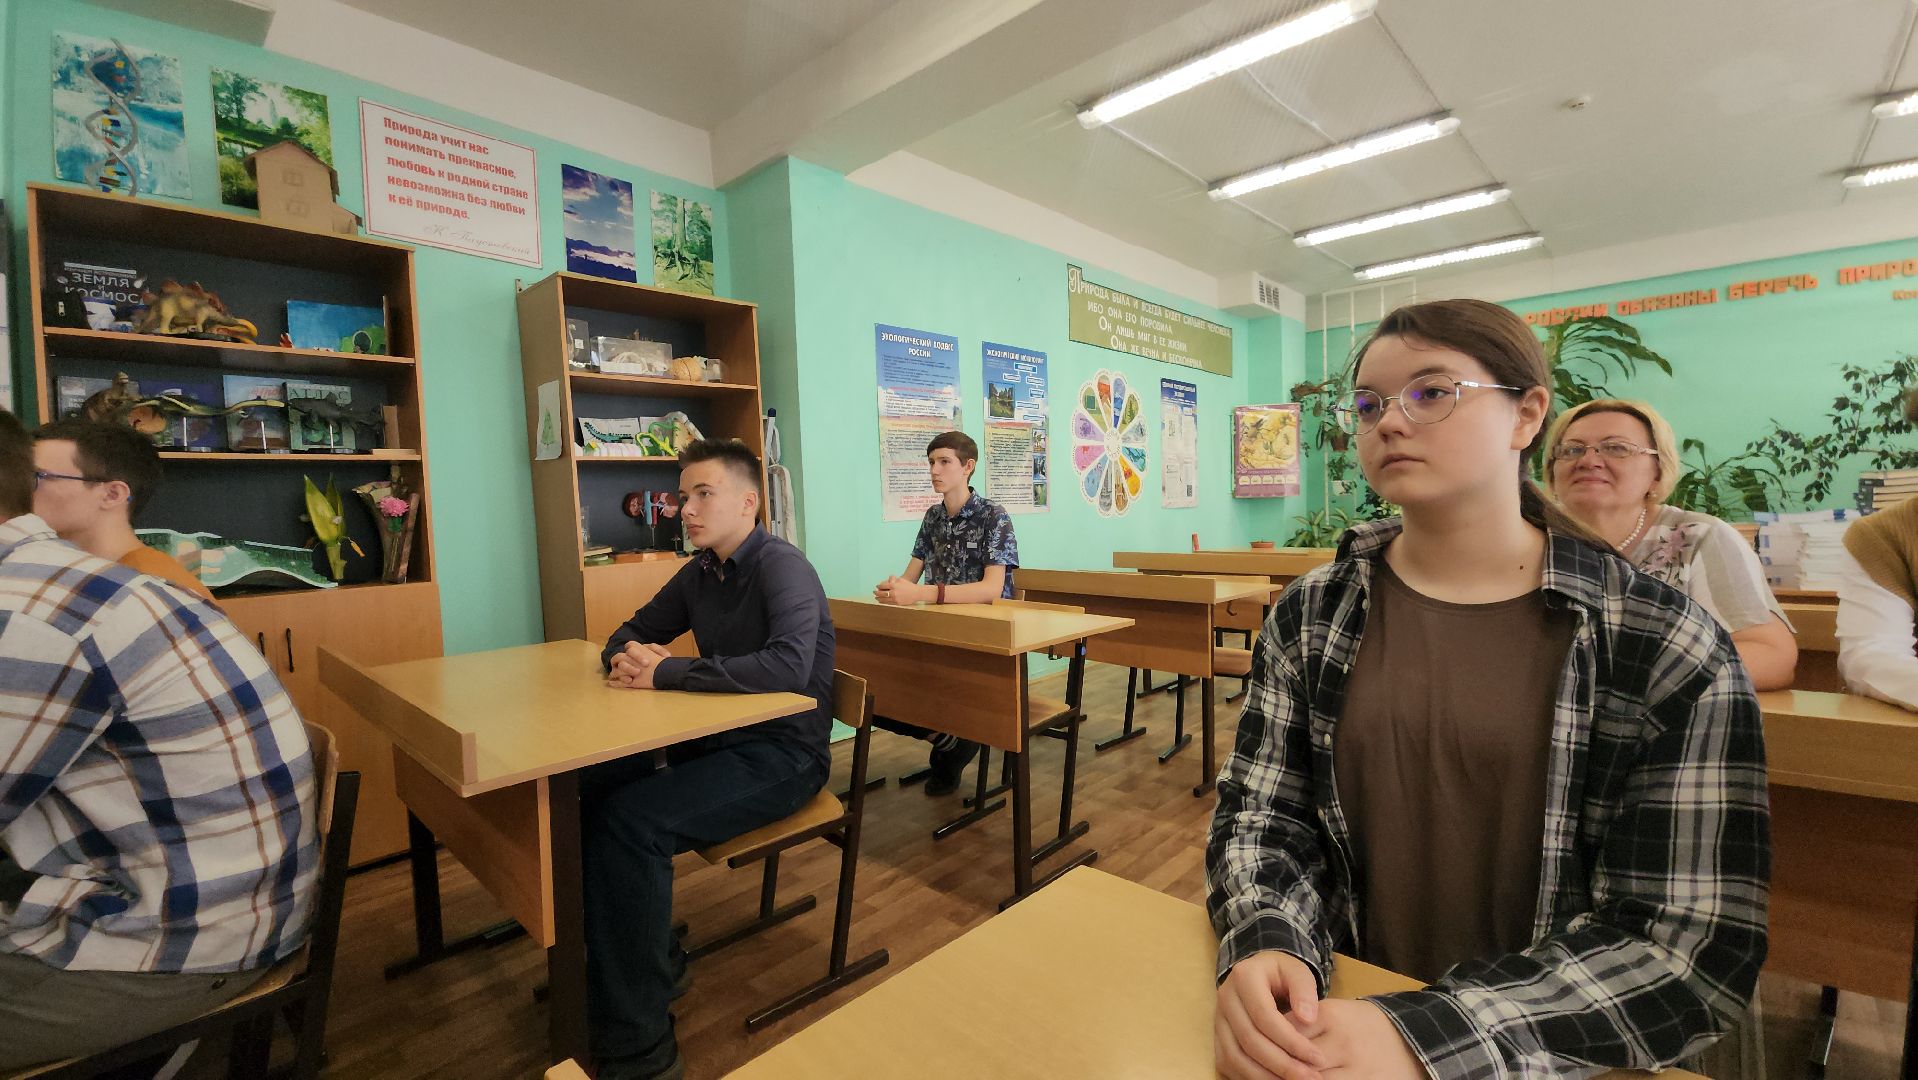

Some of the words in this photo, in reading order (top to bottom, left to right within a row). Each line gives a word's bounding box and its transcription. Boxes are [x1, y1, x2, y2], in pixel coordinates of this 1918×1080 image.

[384, 117, 438, 141] Природа
[440, 134, 467, 149] учит
[468, 144, 489, 155] нас
[384, 136, 445, 160] понимать
[448, 153, 516, 179] прекрасное,
[386, 157, 435, 177] любовь
[438, 169, 445, 178] к
[448, 173, 490, 190] родной
[492, 184, 529, 200] стране
[387, 176, 465, 201] невозможна
[467, 193, 487, 206] без
[490, 200, 526, 215] любви
[388, 194, 396, 203] к
[398, 195, 413, 207] её
[416, 200, 470, 219] природе.
[72, 272, 129, 288] ЗЕМЛЯ
[1616, 288, 1718, 316] ОБЯЗАНЫ
[1728, 273, 1818, 300] БЕРЕЧЬ
[1838, 258, 1918, 285] ПРИРО
[1087, 301, 1104, 314] ИБО
[1107, 306, 1122, 320] ОНА
[1125, 312, 1137, 324] ЕГО
[1140, 316, 1173, 334] ПОРОДИЛА
[1112, 292, 1130, 307] БЫЛА
[1133, 299, 1139, 309] И
[1141, 301, 1162, 317] ВСЕГДА
[1165, 310, 1181, 322] БУДЕТ
[1116, 325, 1135, 338] ЛИШЬ
[1138, 331, 1151, 342] МИГ
[908, 347, 931, 358] РОССИИ
[1131, 343, 1140, 354] ЖЕ
[1142, 346, 1159, 359] ВЕЧНА
[1162, 351, 1167, 360] И
[289, 388, 349, 401] АТЛС
